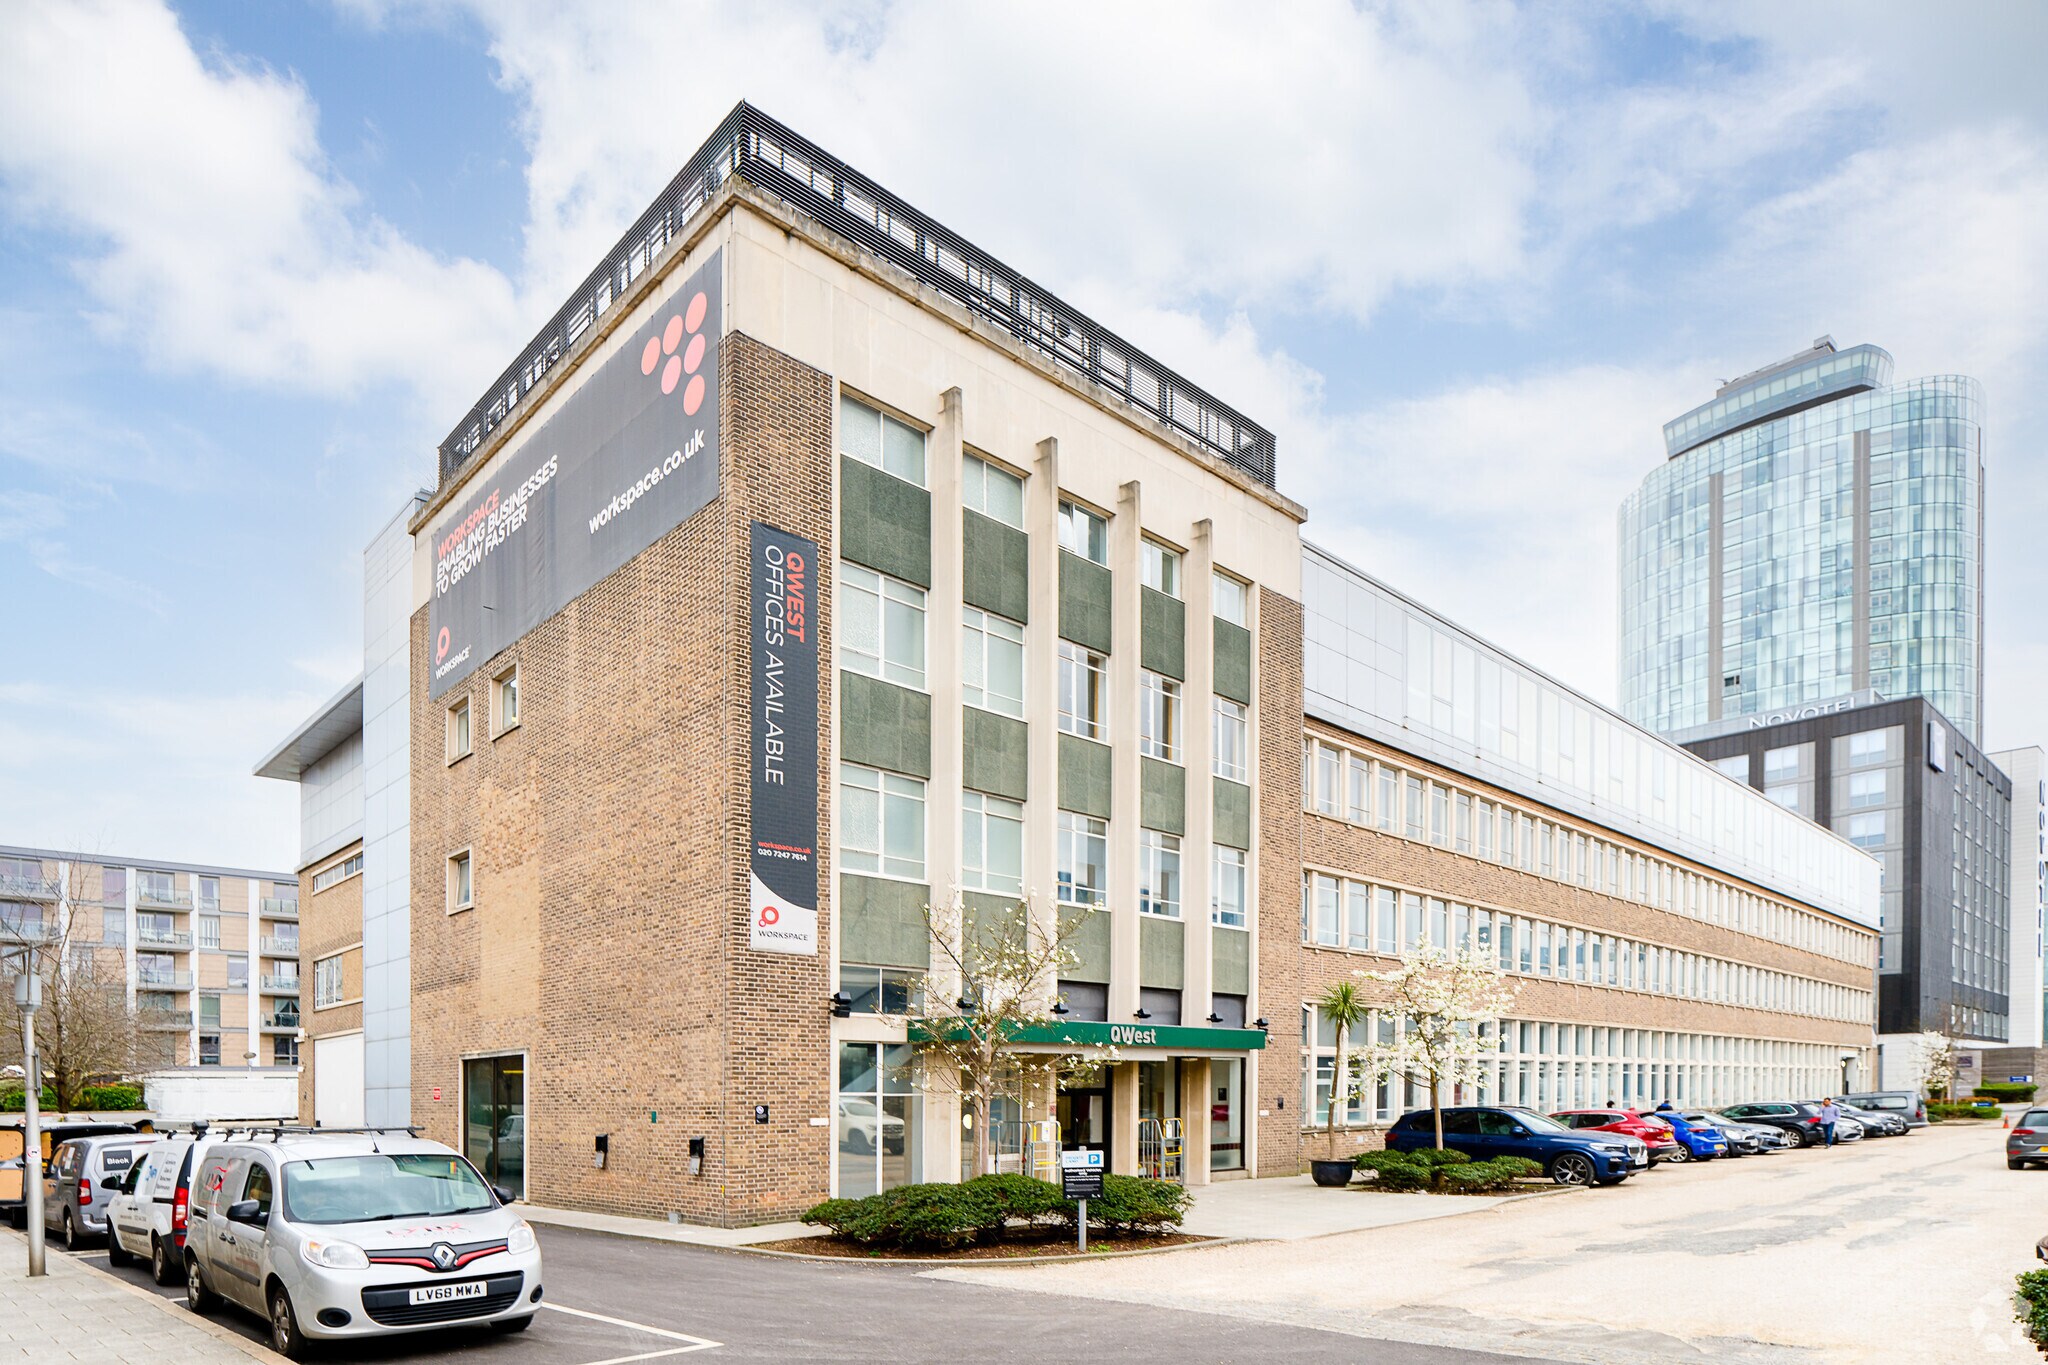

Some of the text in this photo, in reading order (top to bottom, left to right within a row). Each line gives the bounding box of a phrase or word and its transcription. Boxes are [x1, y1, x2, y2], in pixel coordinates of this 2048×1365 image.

[589, 428, 705, 534] workspace.co.uk
[436, 454, 558, 580] ENABLING BUSINESSES
[437, 487, 500, 560] WORKSPACE
[435, 503, 527, 598] TO GROW FASTER
[786, 551, 805, 643] QWEST
[435, 646, 470, 680] WORKSPACE
[764, 544, 784, 786] OFFICES AVAILABLE
[757, 841, 812, 854] workspace.co.uk
[757, 848, 773, 857] 020
[773, 850, 790, 860] 7247
[758, 930, 809, 941] WORKSPACE
[1110, 1025, 1156, 1045] QWest
[106, 1157, 130, 1165] Black
[416, 1284, 481, 1302] LV68 MWA
